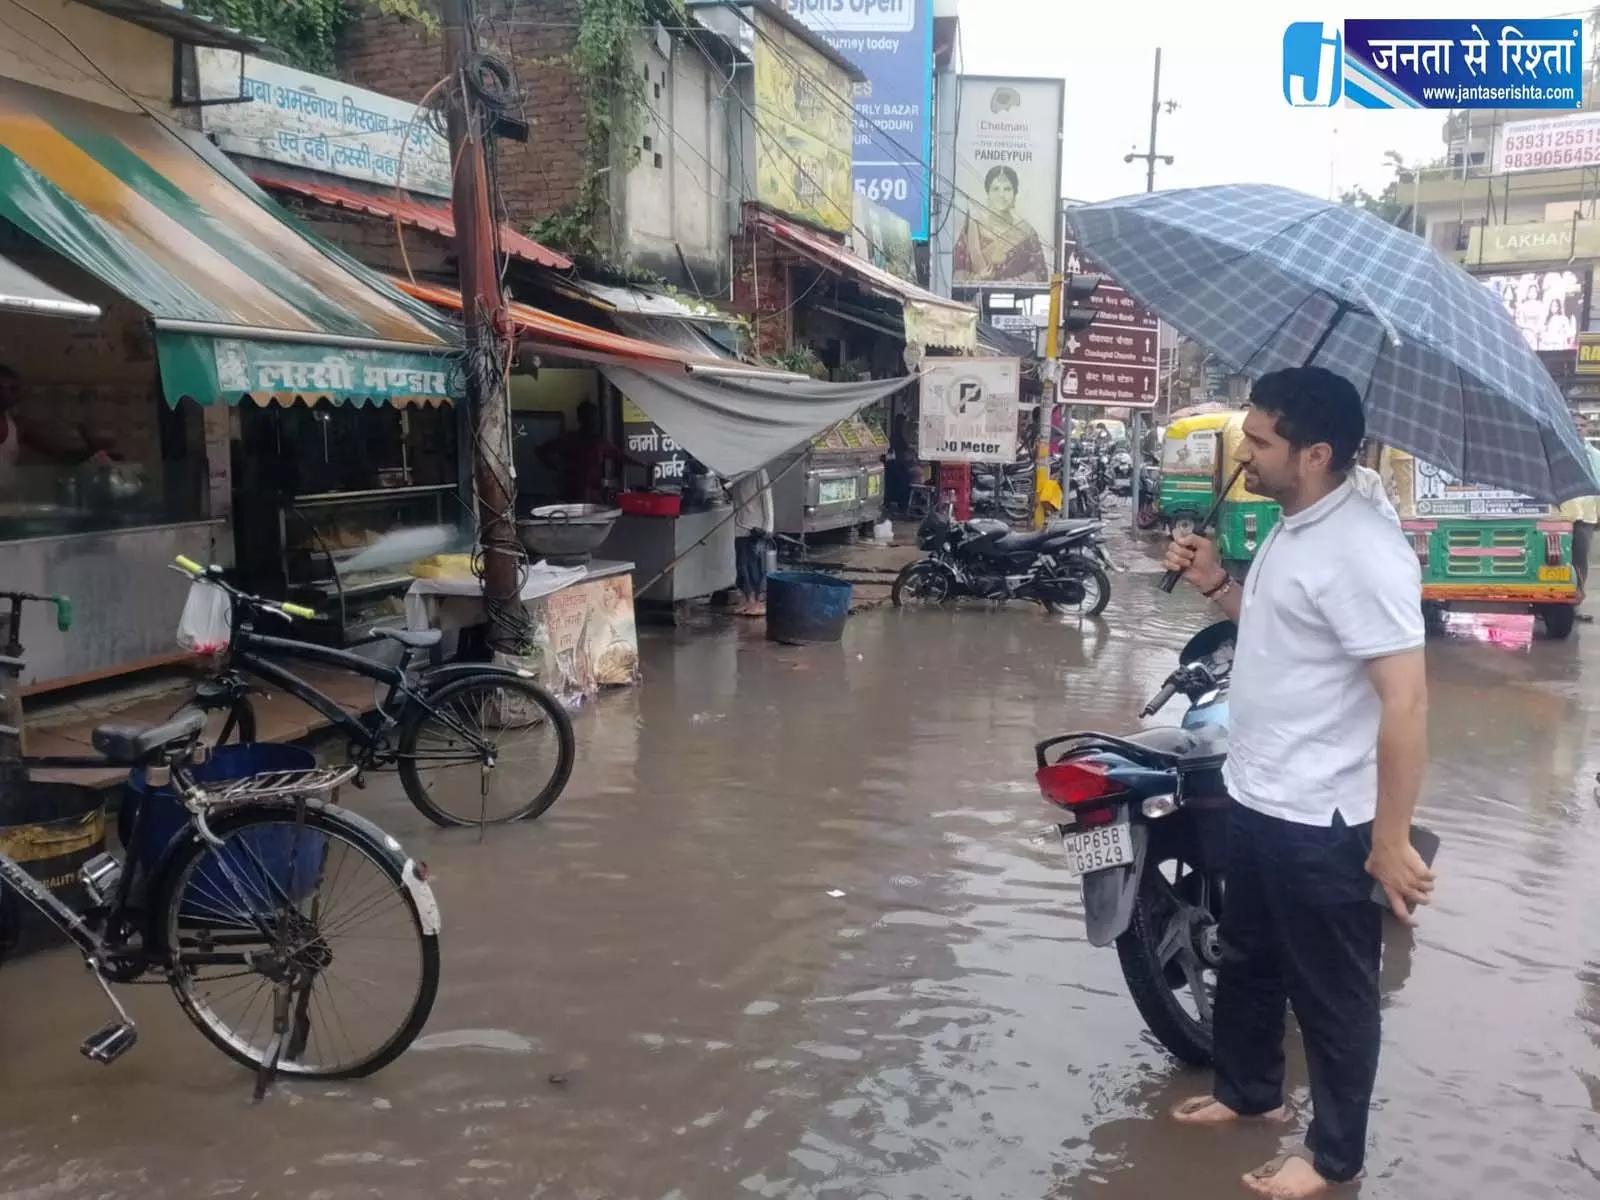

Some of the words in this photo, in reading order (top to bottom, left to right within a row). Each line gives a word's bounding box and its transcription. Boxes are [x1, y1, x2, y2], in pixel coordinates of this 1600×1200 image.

[866, 36, 900, 54] today
[883, 104, 919, 117] BAZAR
[974, 150, 1033, 162] PANDEYPUR
[853, 178, 908, 200] 5690
[253, 356, 354, 390] लस्सी
[628, 428, 659, 452] नमो
[960, 441, 1001, 454] Meter
